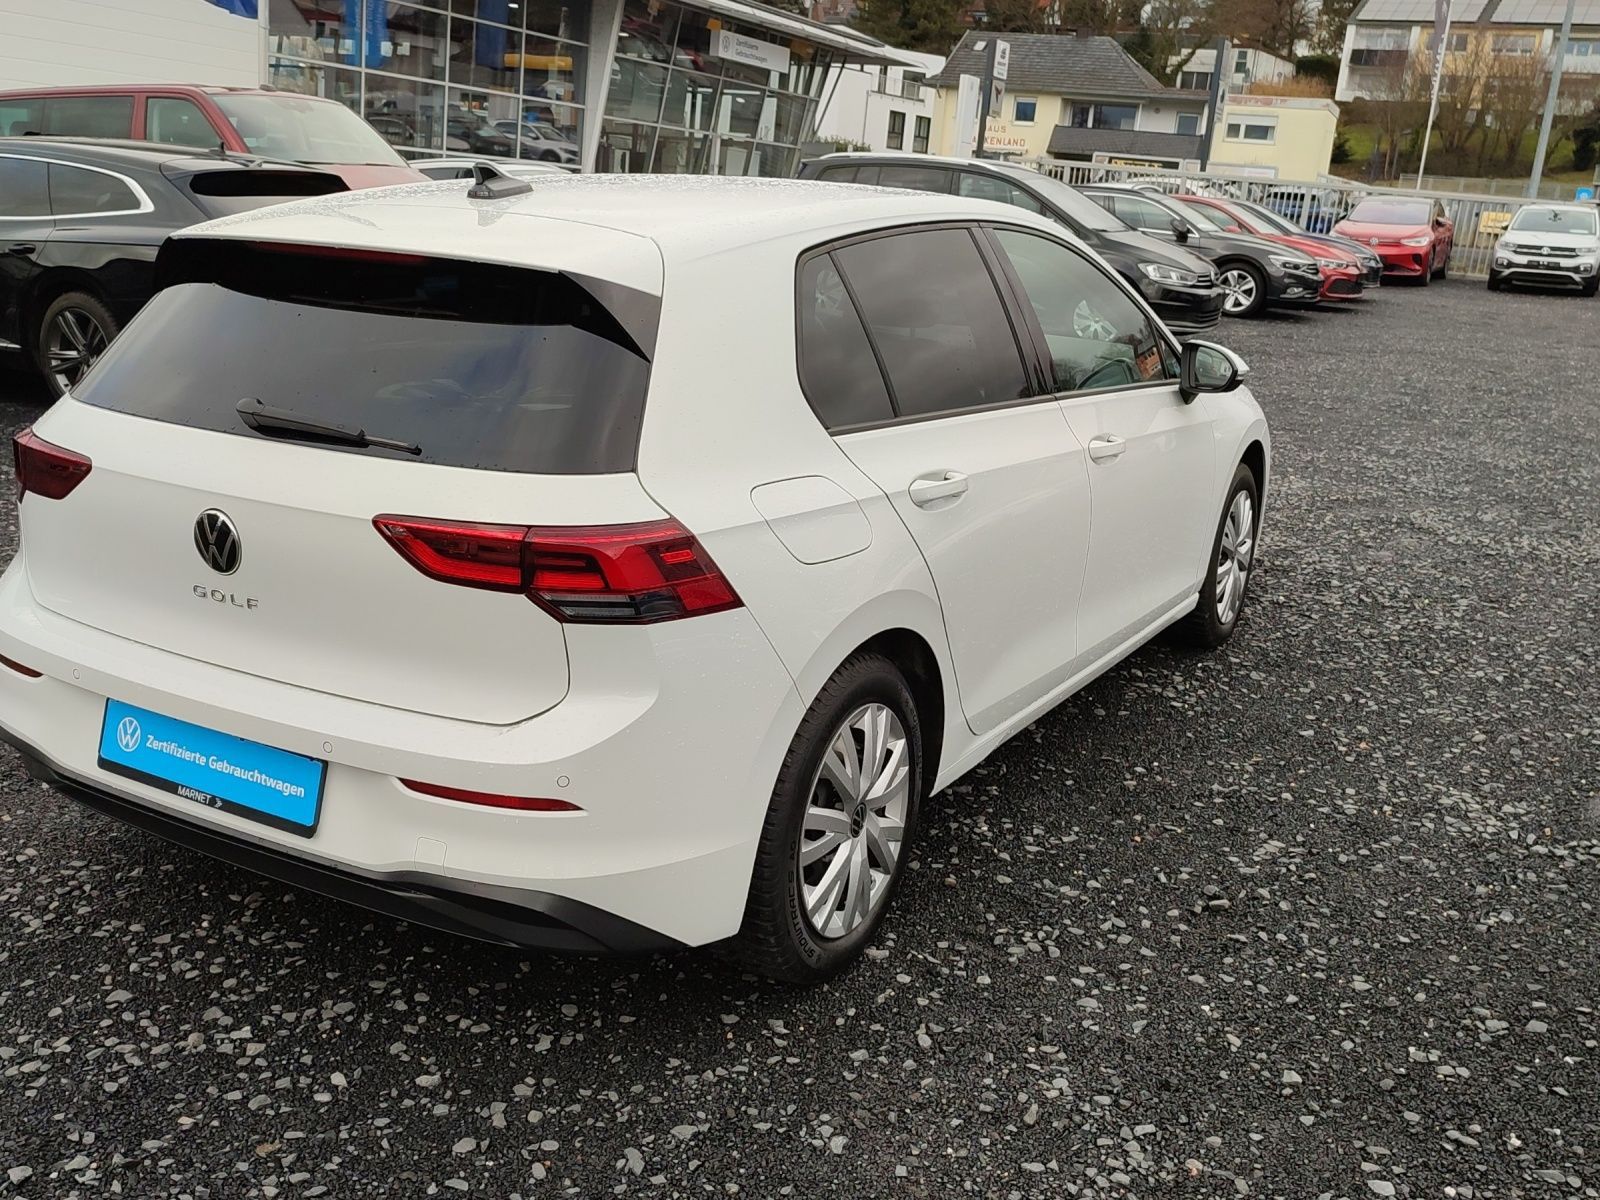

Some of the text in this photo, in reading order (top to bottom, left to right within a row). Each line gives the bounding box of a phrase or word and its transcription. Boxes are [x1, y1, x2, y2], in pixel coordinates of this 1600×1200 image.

[987, 125, 1007, 134] AUS
[194, 508, 242, 576] VW
[193, 584, 259, 609] GOLF
[117, 716, 141, 752] VW
[146, 734, 305, 798] Zertifizierte Gebrauchtwagen
[177, 785, 213, 805] MARNET
